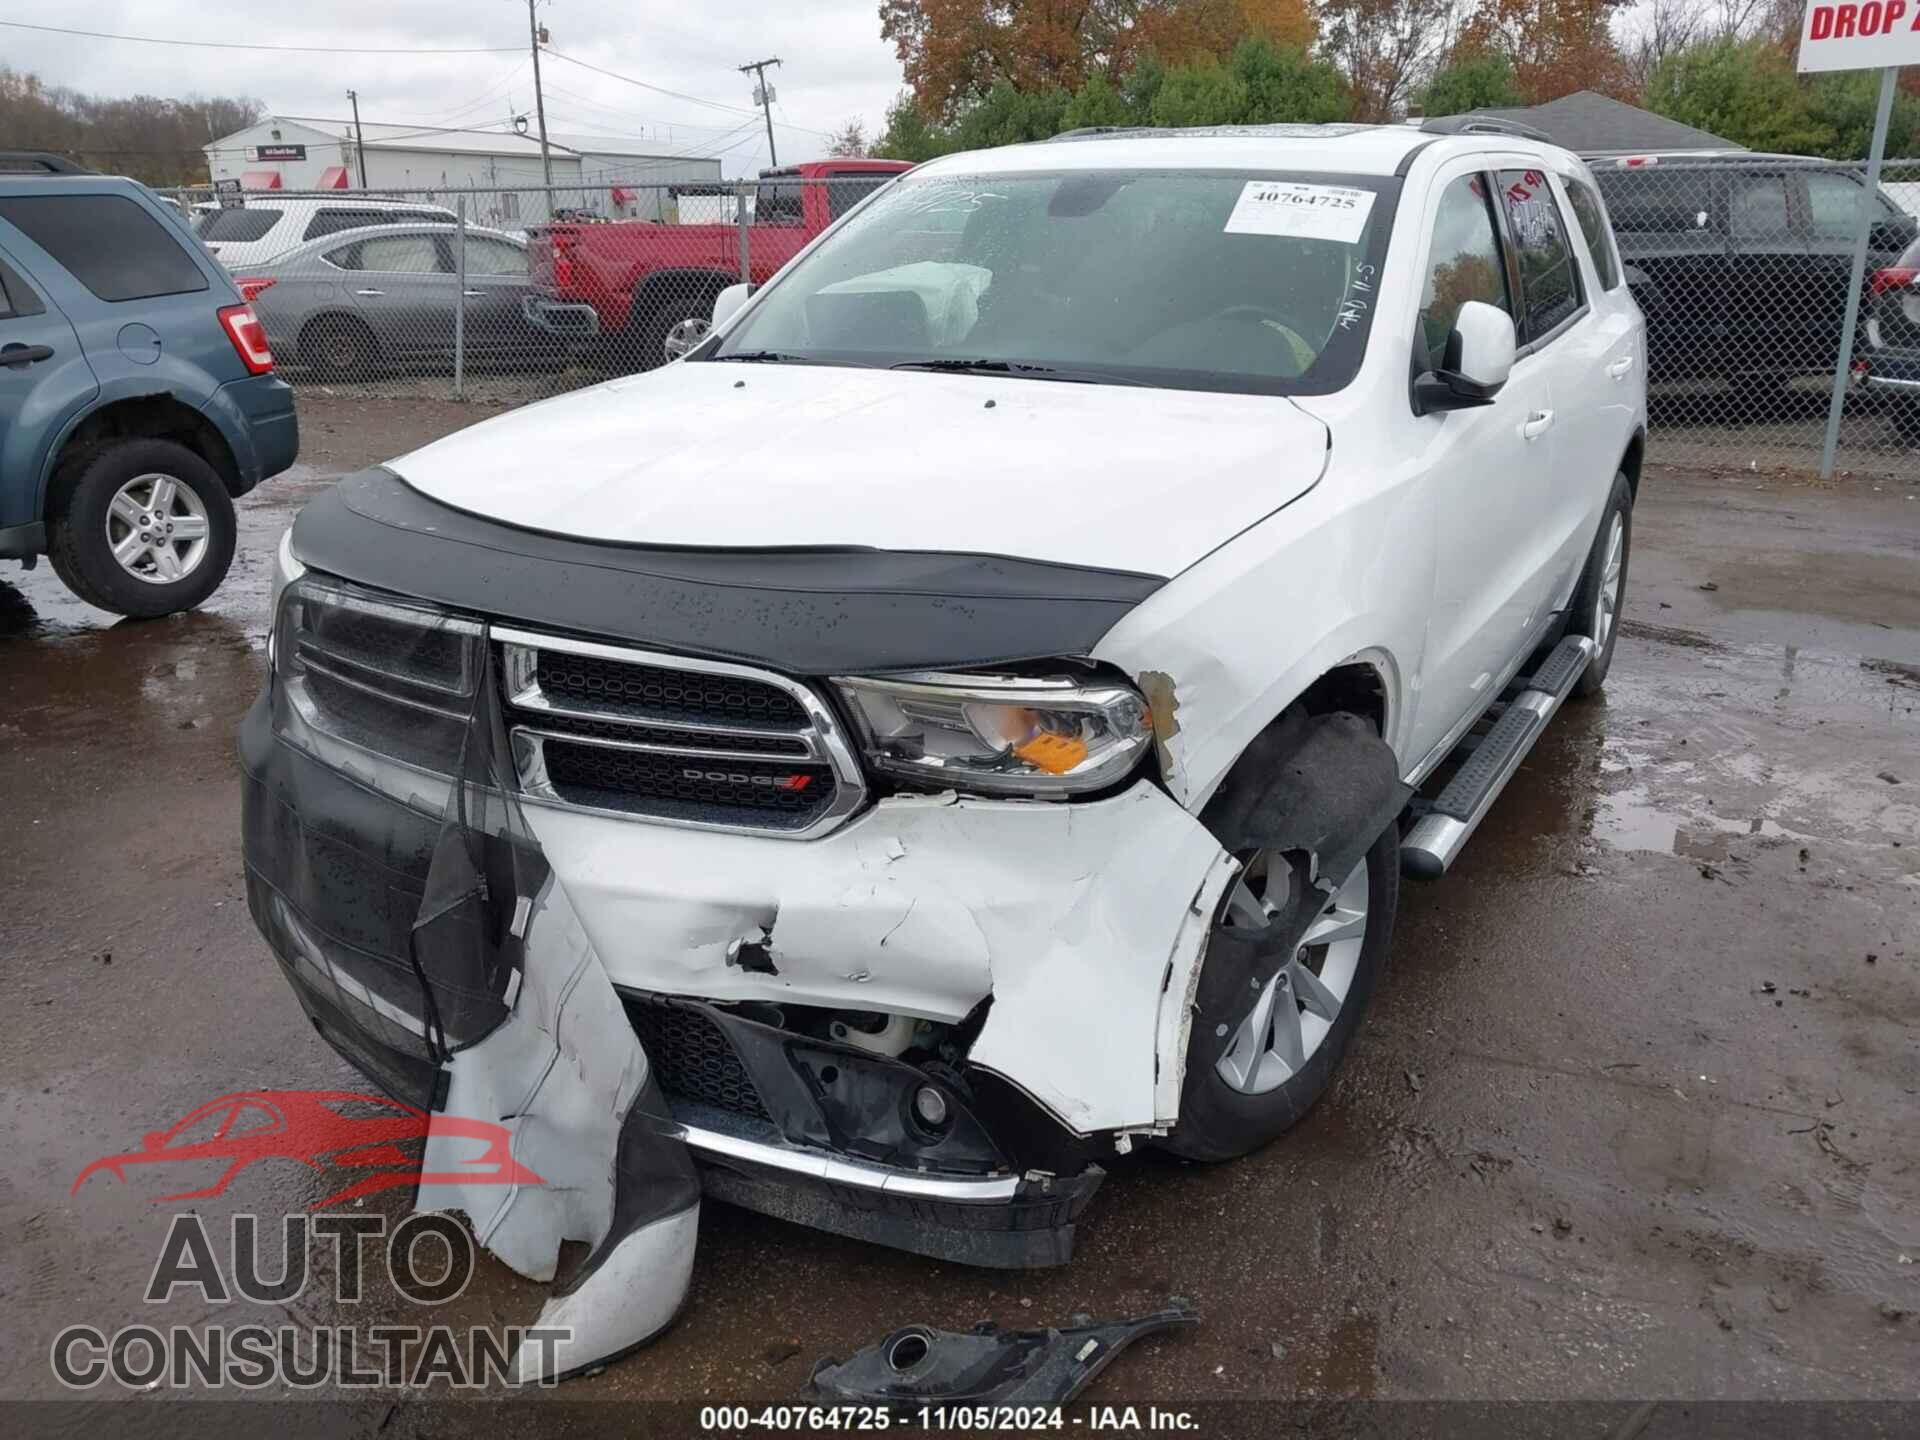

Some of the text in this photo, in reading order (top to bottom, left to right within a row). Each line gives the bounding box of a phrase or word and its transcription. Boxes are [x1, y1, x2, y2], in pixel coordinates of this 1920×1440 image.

[1810, 0, 1906, 40] DROP
[1253, 190, 1356, 210] 40764725
[683, 769, 794, 786] DODGE
